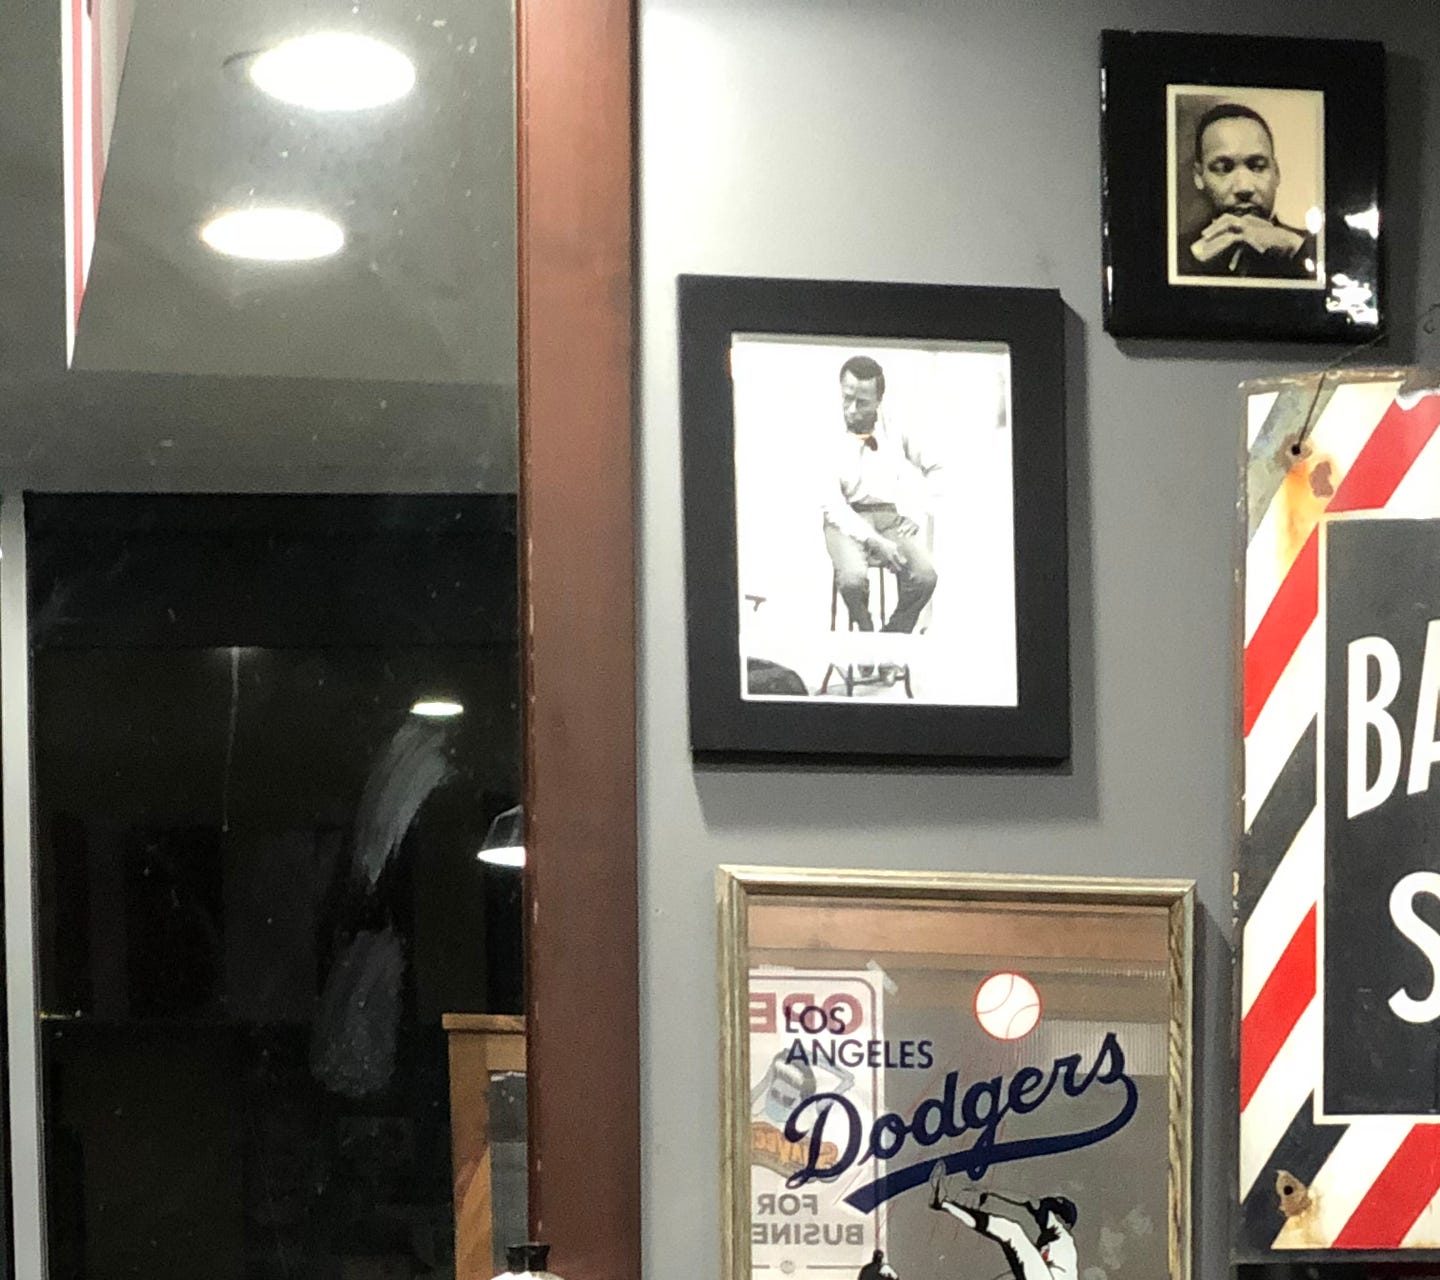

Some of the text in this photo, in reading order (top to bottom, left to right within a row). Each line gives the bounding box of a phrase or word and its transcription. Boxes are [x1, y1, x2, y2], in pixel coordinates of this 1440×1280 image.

[785, 1006, 845, 1034] LOS
[785, 1038, 934, 1068] ANGELES
[784, 1033, 1138, 1190] Dodgers
